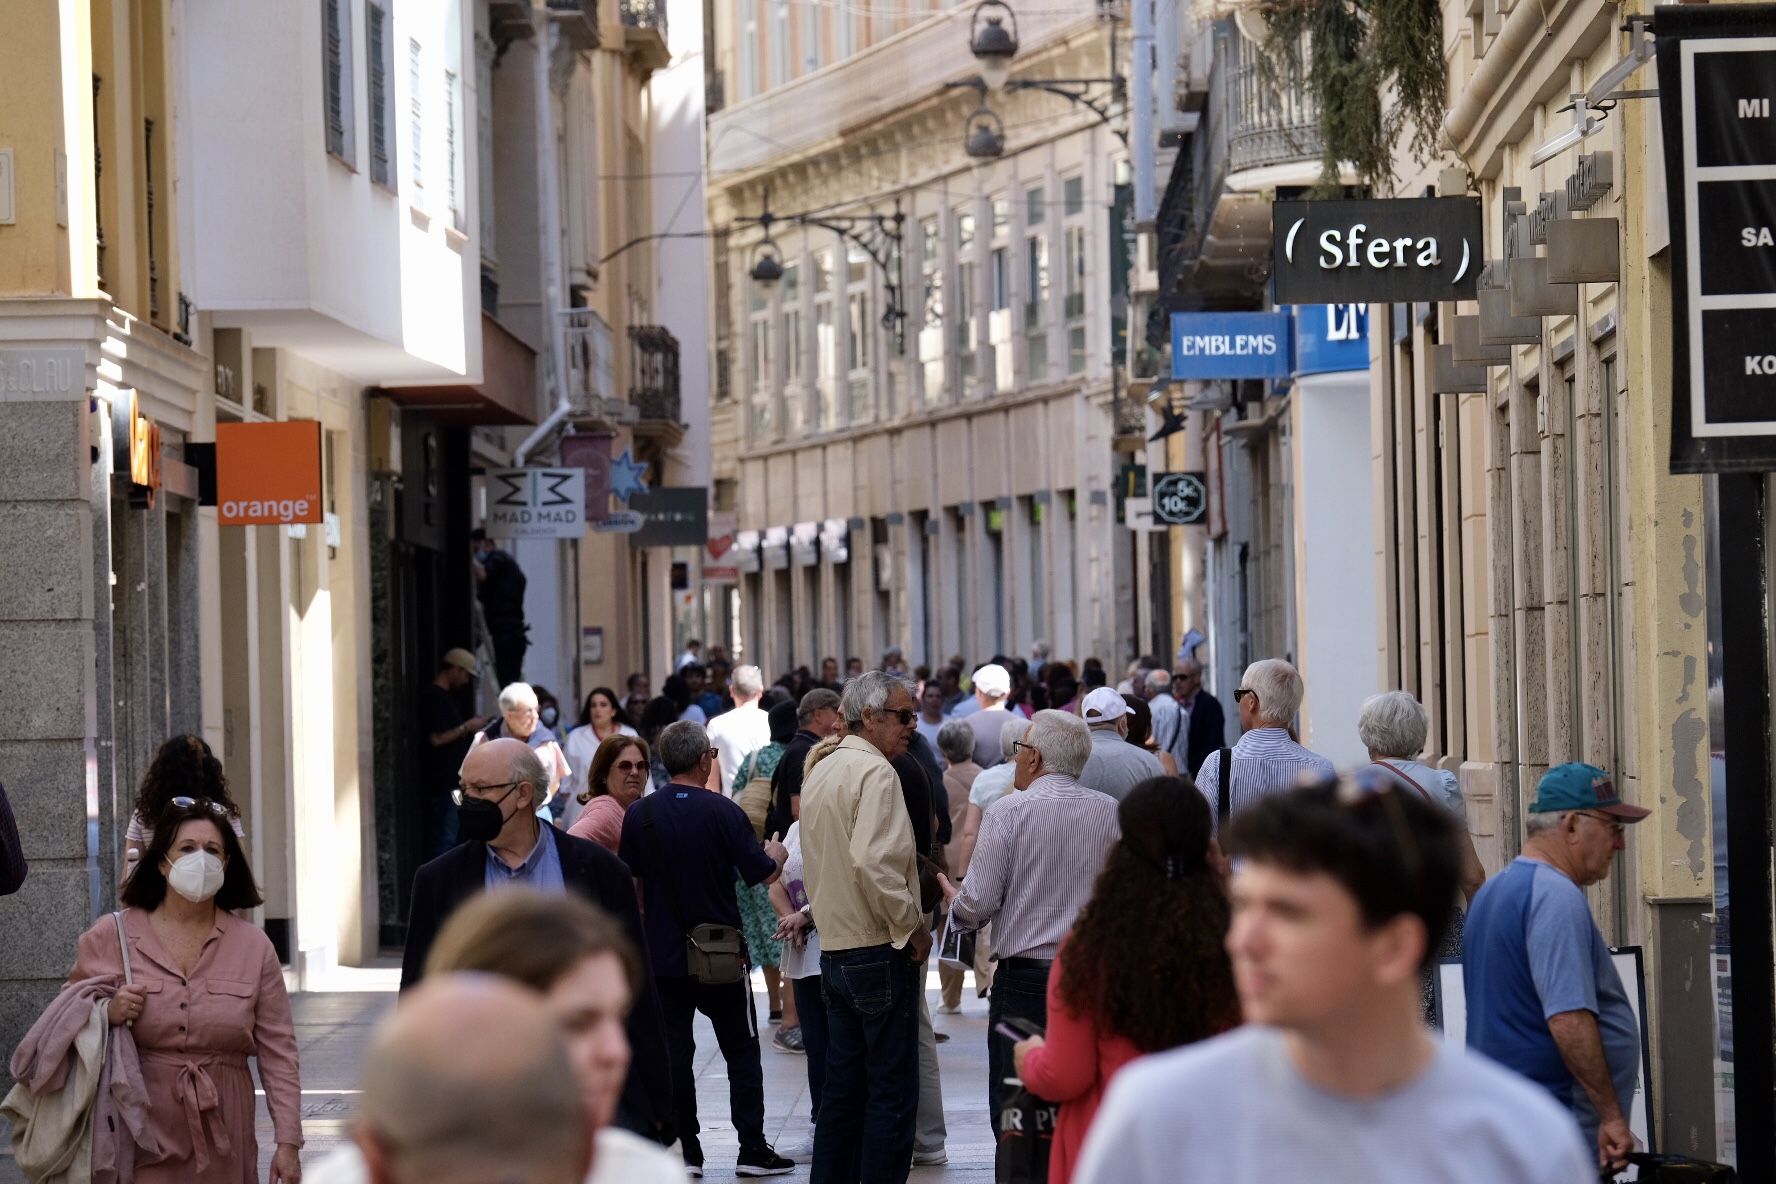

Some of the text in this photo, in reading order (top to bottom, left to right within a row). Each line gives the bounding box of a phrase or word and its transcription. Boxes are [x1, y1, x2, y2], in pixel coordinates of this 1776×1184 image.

[1738, 98, 1770, 119] MI
[1740, 227, 1775, 247] SA
[1182, 334, 1277, 356] EMBLEMS
[1744, 355, 1776, 375] KO
[493, 509, 577, 524] MAD MAD
